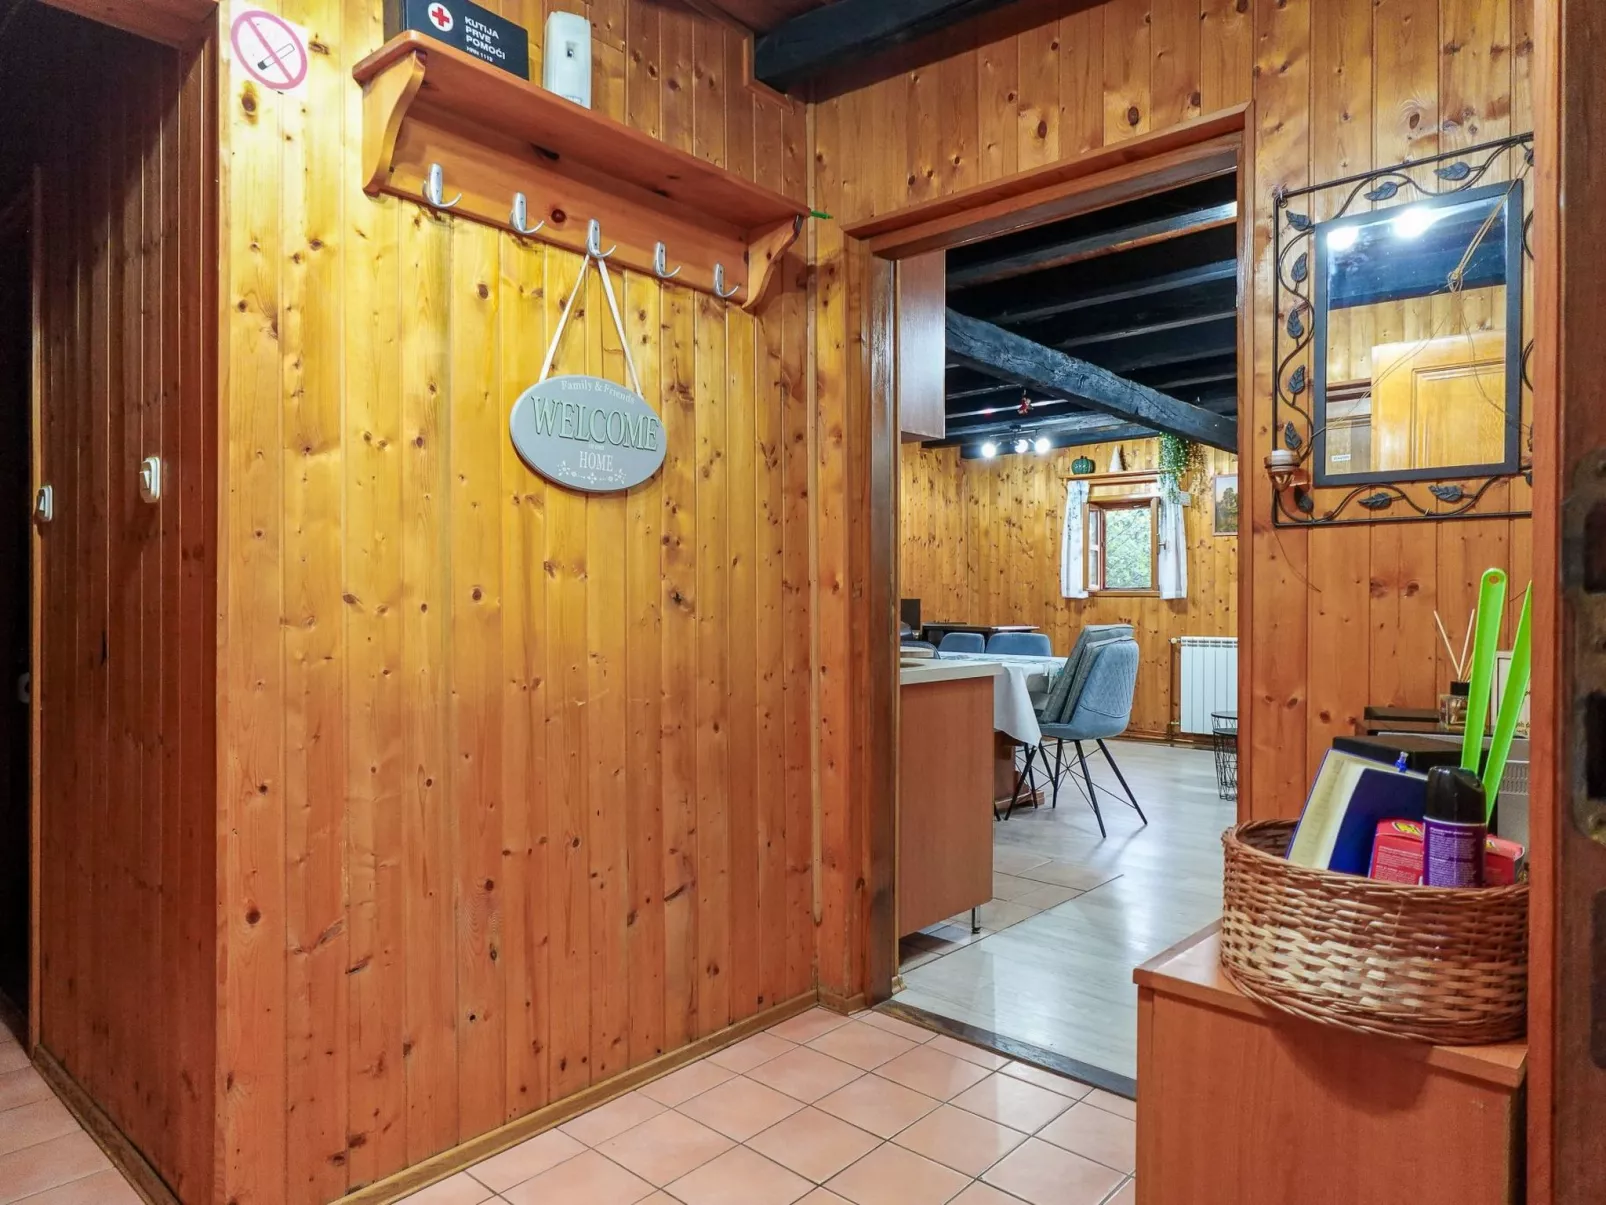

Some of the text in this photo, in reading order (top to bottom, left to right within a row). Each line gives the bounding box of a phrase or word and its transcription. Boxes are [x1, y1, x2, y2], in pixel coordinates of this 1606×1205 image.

[465, 16, 499, 39] KUTIJA
[466, 25, 491, 44] PRVE
[561, 380, 635, 404] Family & Friends
[531, 395, 659, 451] WELCOME
[579, 451, 613, 471] HOME
